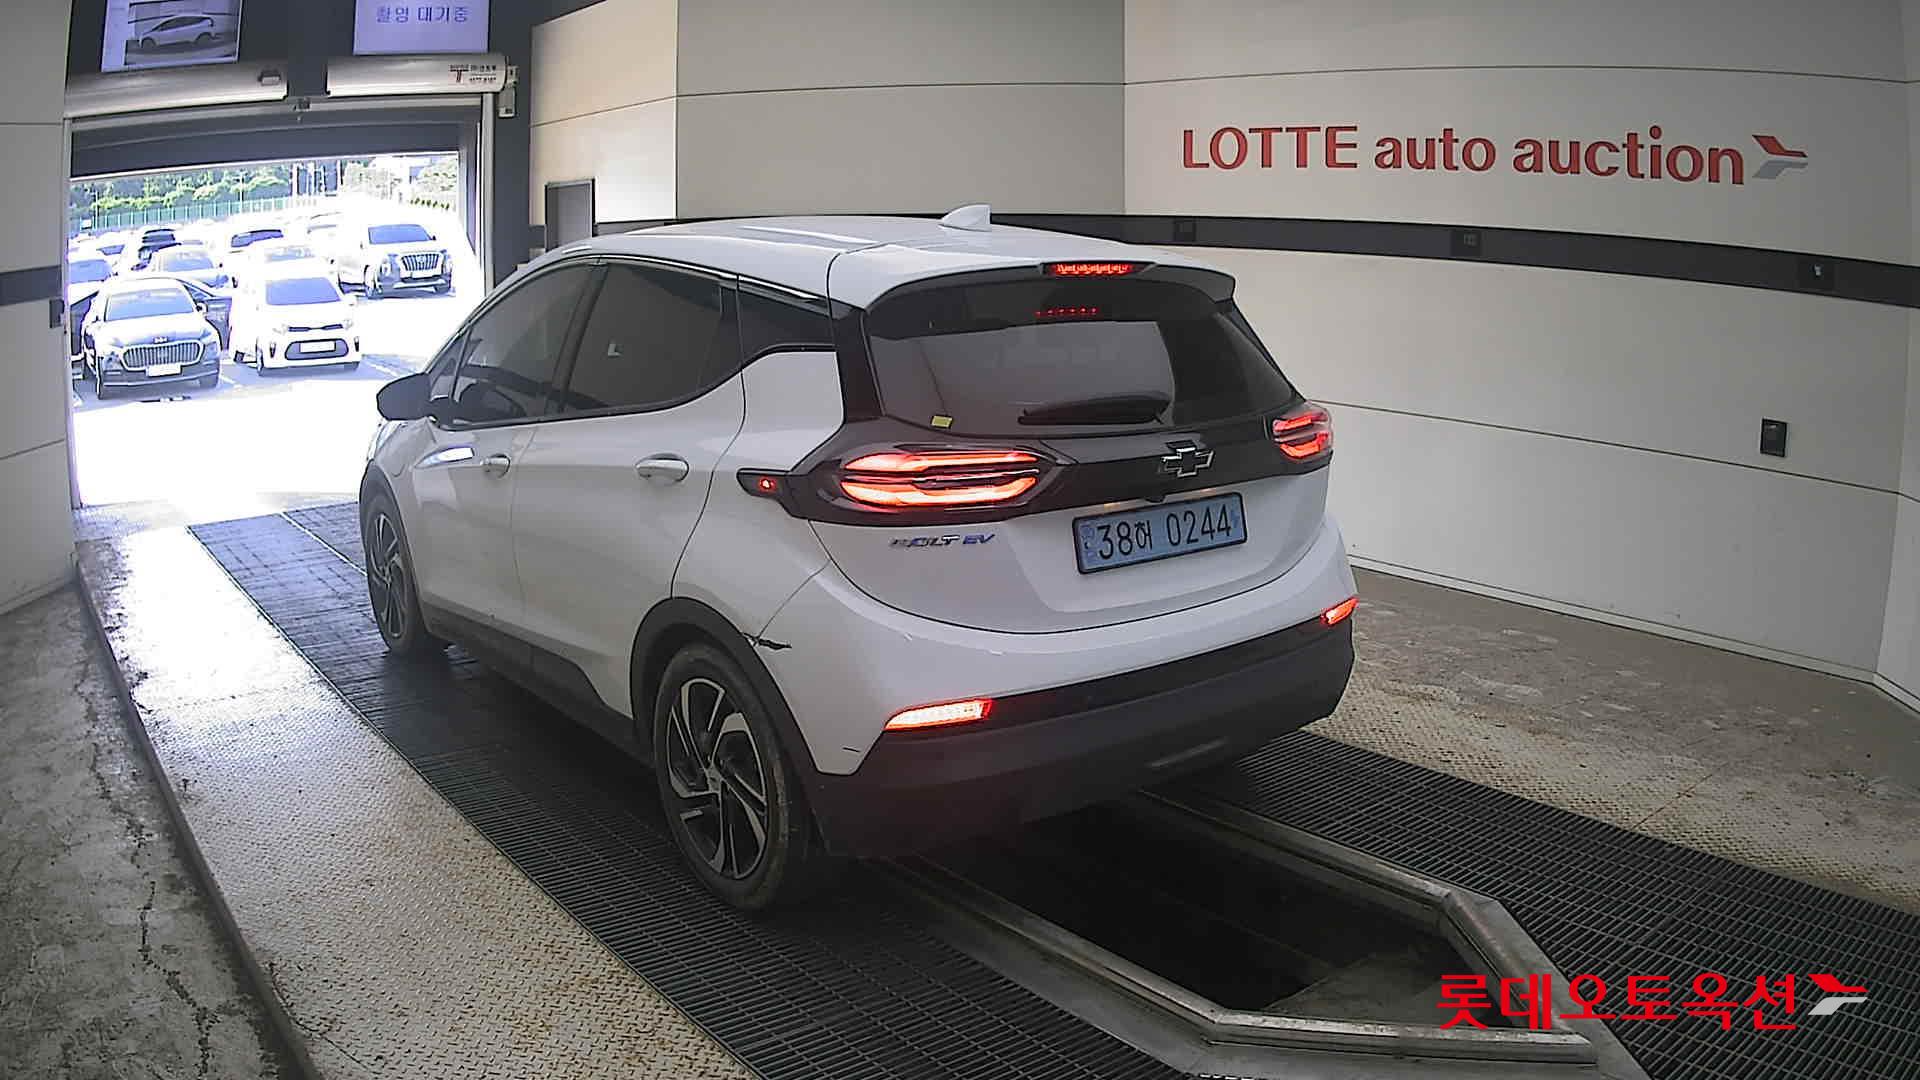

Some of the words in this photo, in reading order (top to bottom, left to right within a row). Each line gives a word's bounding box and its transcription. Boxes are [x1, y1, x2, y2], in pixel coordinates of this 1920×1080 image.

[417, 7, 467, 23] 대기중
[1183, 126, 1358, 170] LOTTE
[1374, 128, 1497, 172] auto
[1512, 125, 1745, 186] auction
[962, 533, 996, 545] EV
[1097, 520, 1153, 560] 38허
[1166, 503, 1232, 547] 0244
